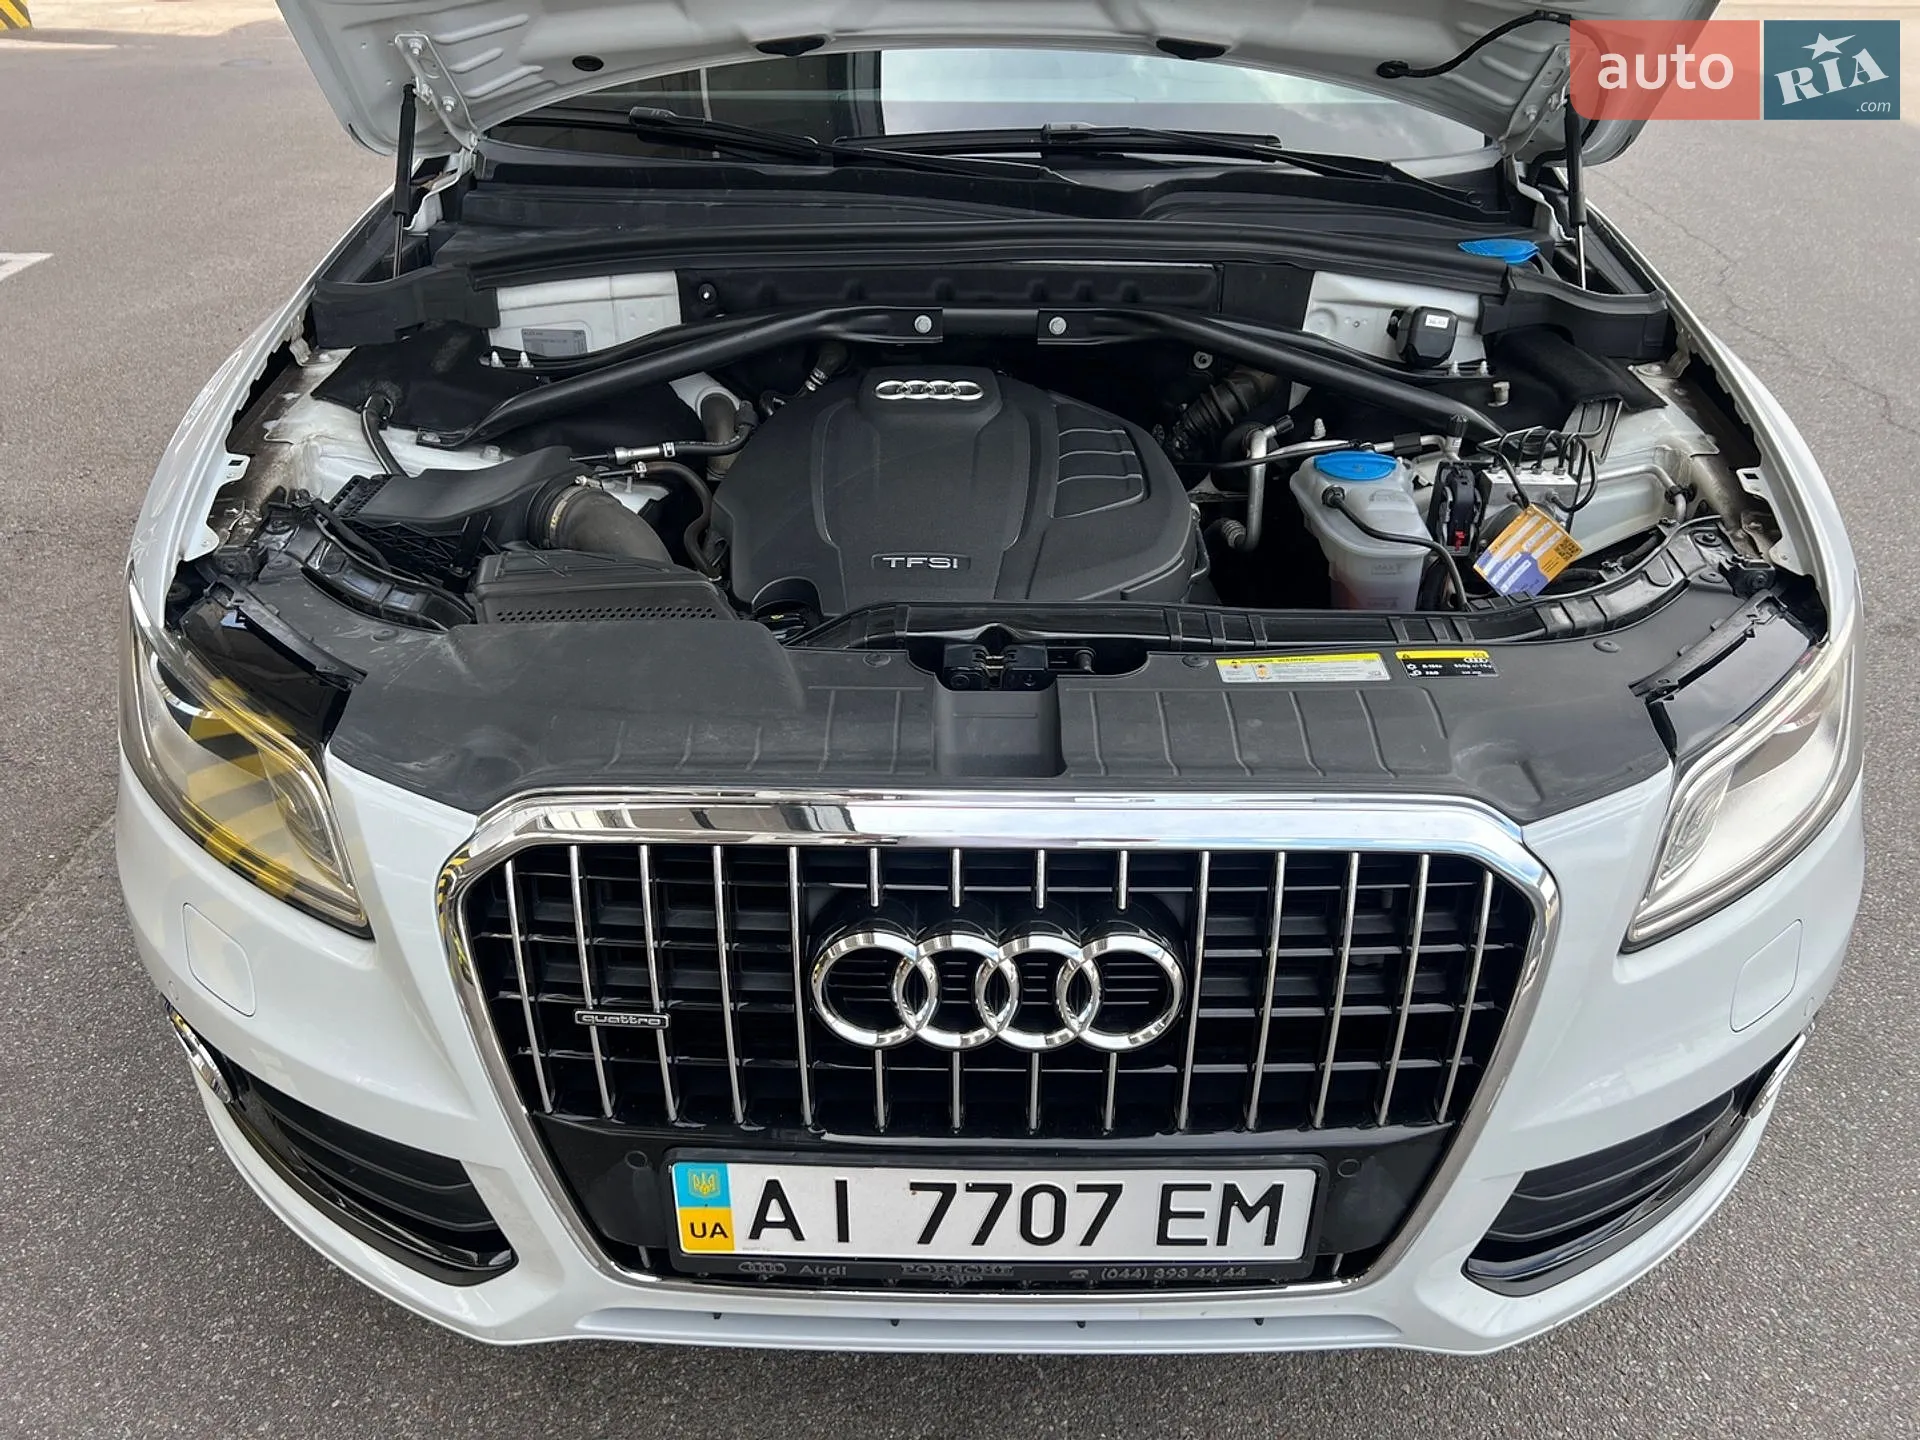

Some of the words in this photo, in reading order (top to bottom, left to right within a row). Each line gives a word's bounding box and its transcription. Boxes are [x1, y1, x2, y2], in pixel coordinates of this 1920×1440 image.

[882, 557, 958, 569] TFSI
[582, 1014, 661, 1026] quattro
[747, 1178, 851, 1243] AI
[909, 1182, 1124, 1246] 7707
[1155, 1183, 1284, 1247] EM
[689, 1222, 729, 1239] UA
[799, 1264, 847, 1276] Audi
[1101, 1267, 1148, 1281] (044)
[1154, 1267, 1189, 1279] 393
[1193, 1267, 1218, 1278] 44
[1223, 1266, 1247, 1277] 44
